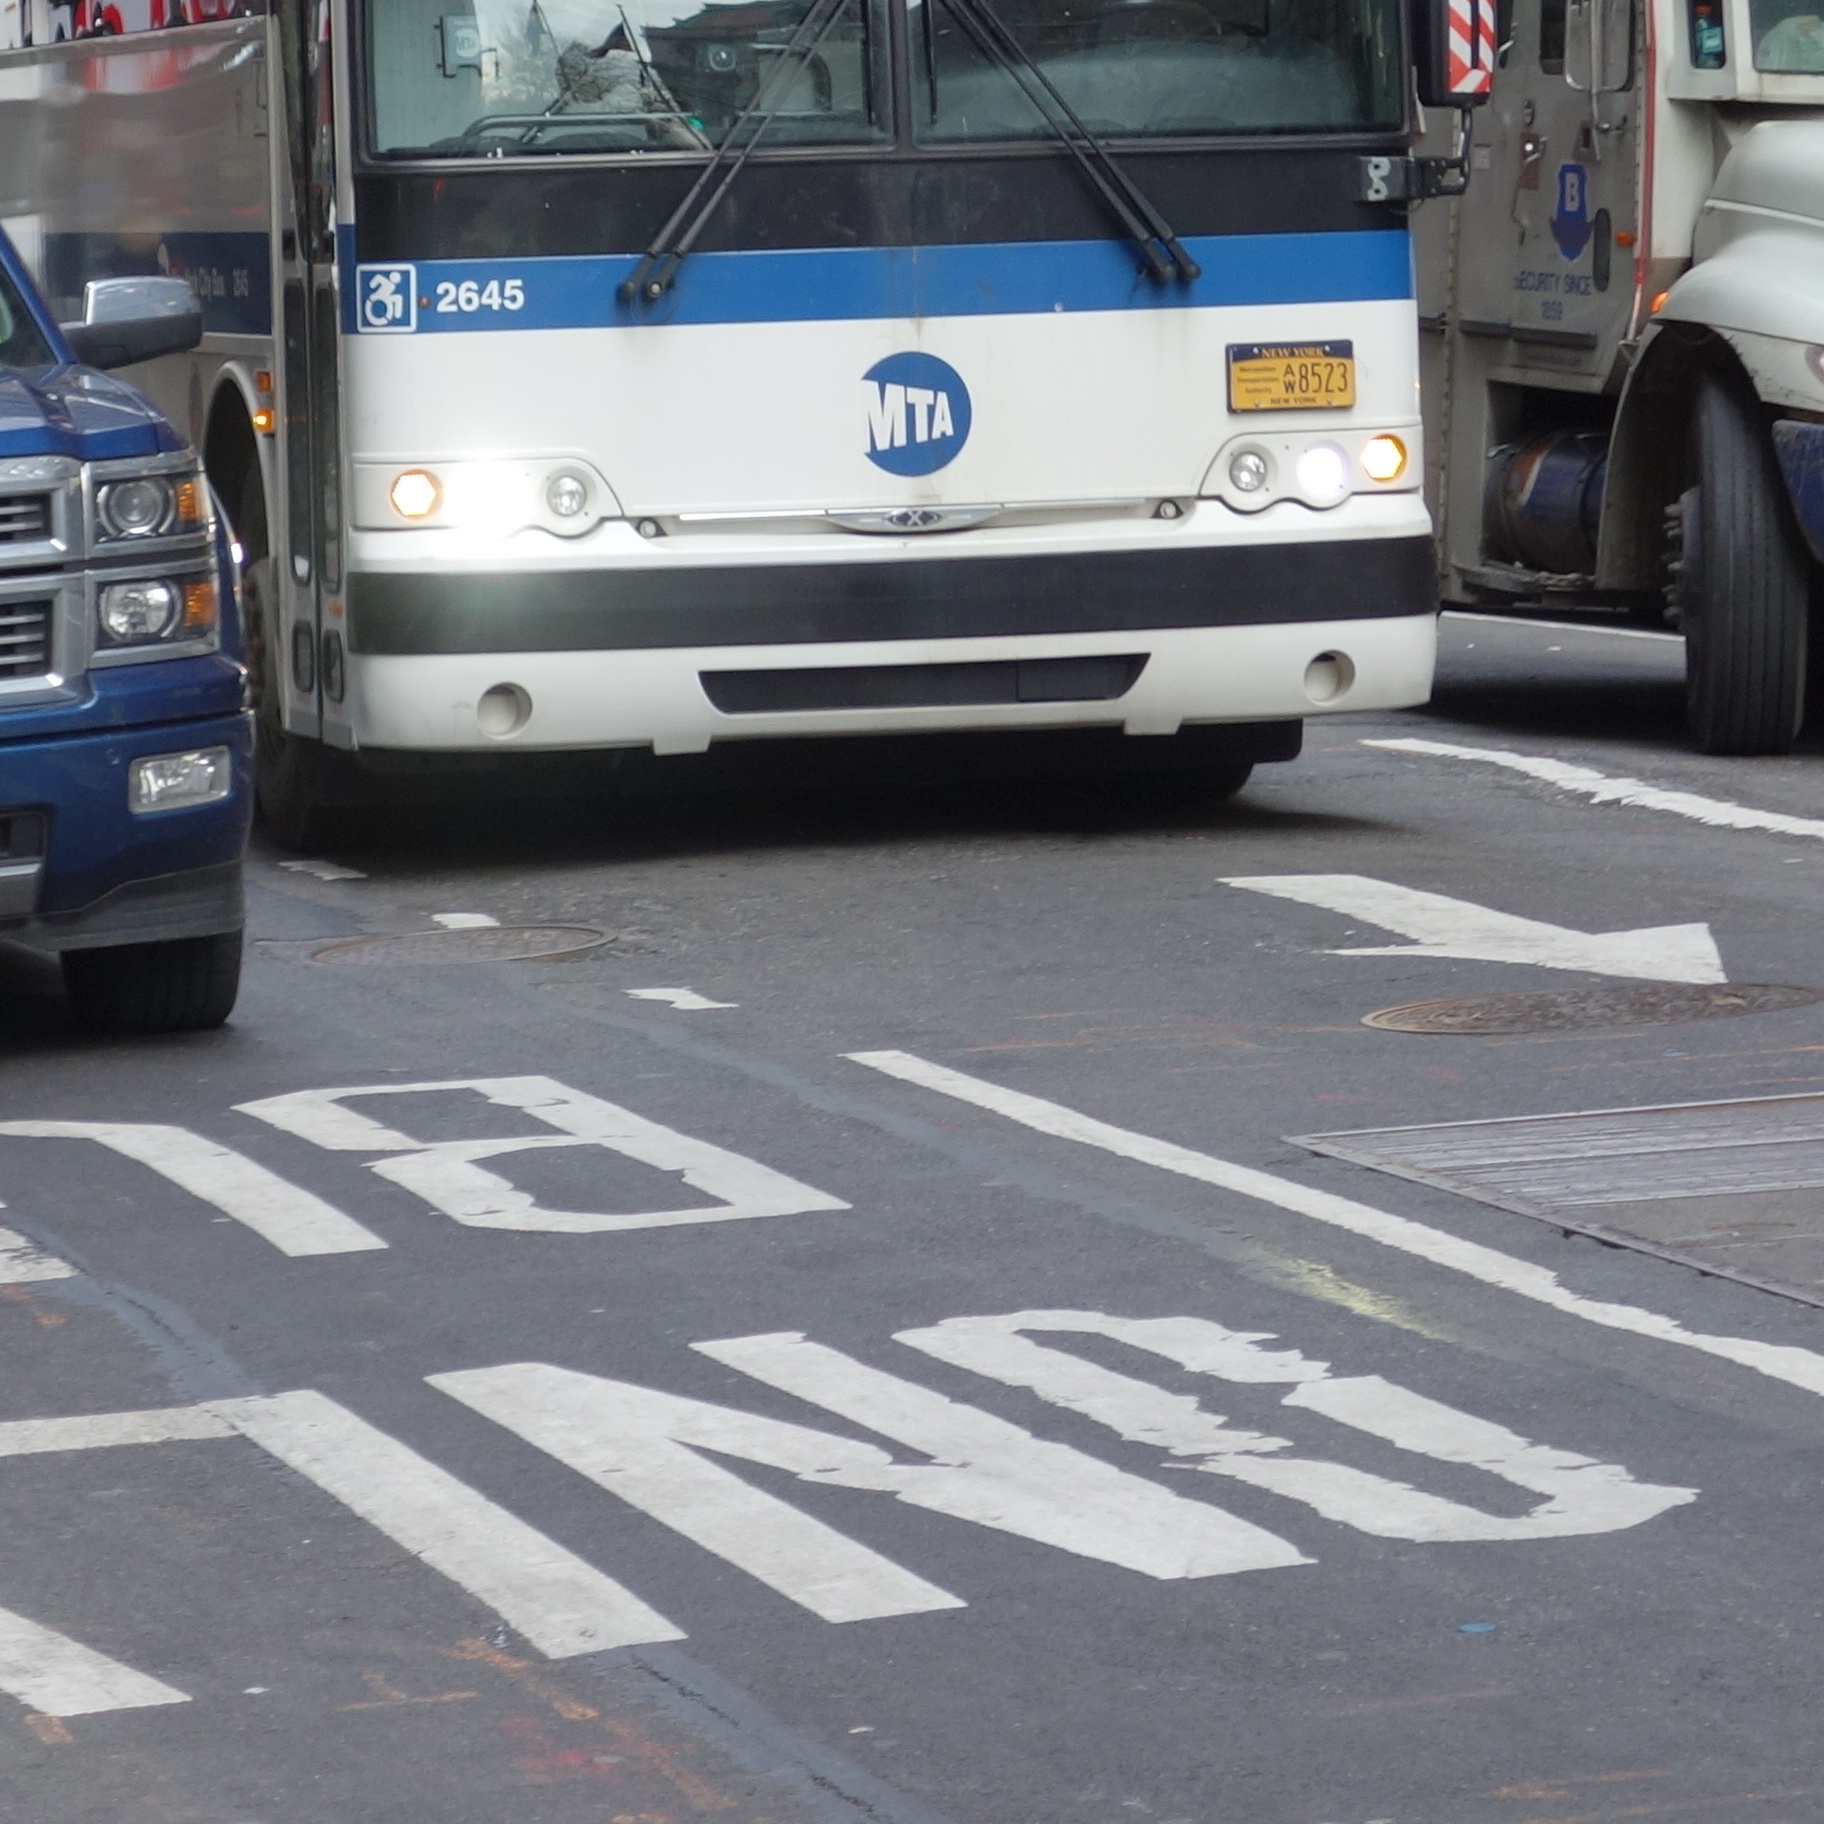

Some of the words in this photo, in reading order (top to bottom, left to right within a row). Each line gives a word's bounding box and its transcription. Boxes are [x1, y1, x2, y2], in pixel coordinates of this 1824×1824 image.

[1564, 172, 1580, 212] B
[435, 279, 525, 313] 2645
[1515, 270, 1560, 293] SECURITY
[1563, 273, 1592, 295] SINCE
[1261, 347, 1291, 359] NEW
[1293, 346, 1325, 358] YORK
[1298, 362, 1349, 394] 8523
[859, 379, 955, 453] MTA
[1270, 397, 1291, 405] NEW
[1294, 395, 1318, 404] YORK
